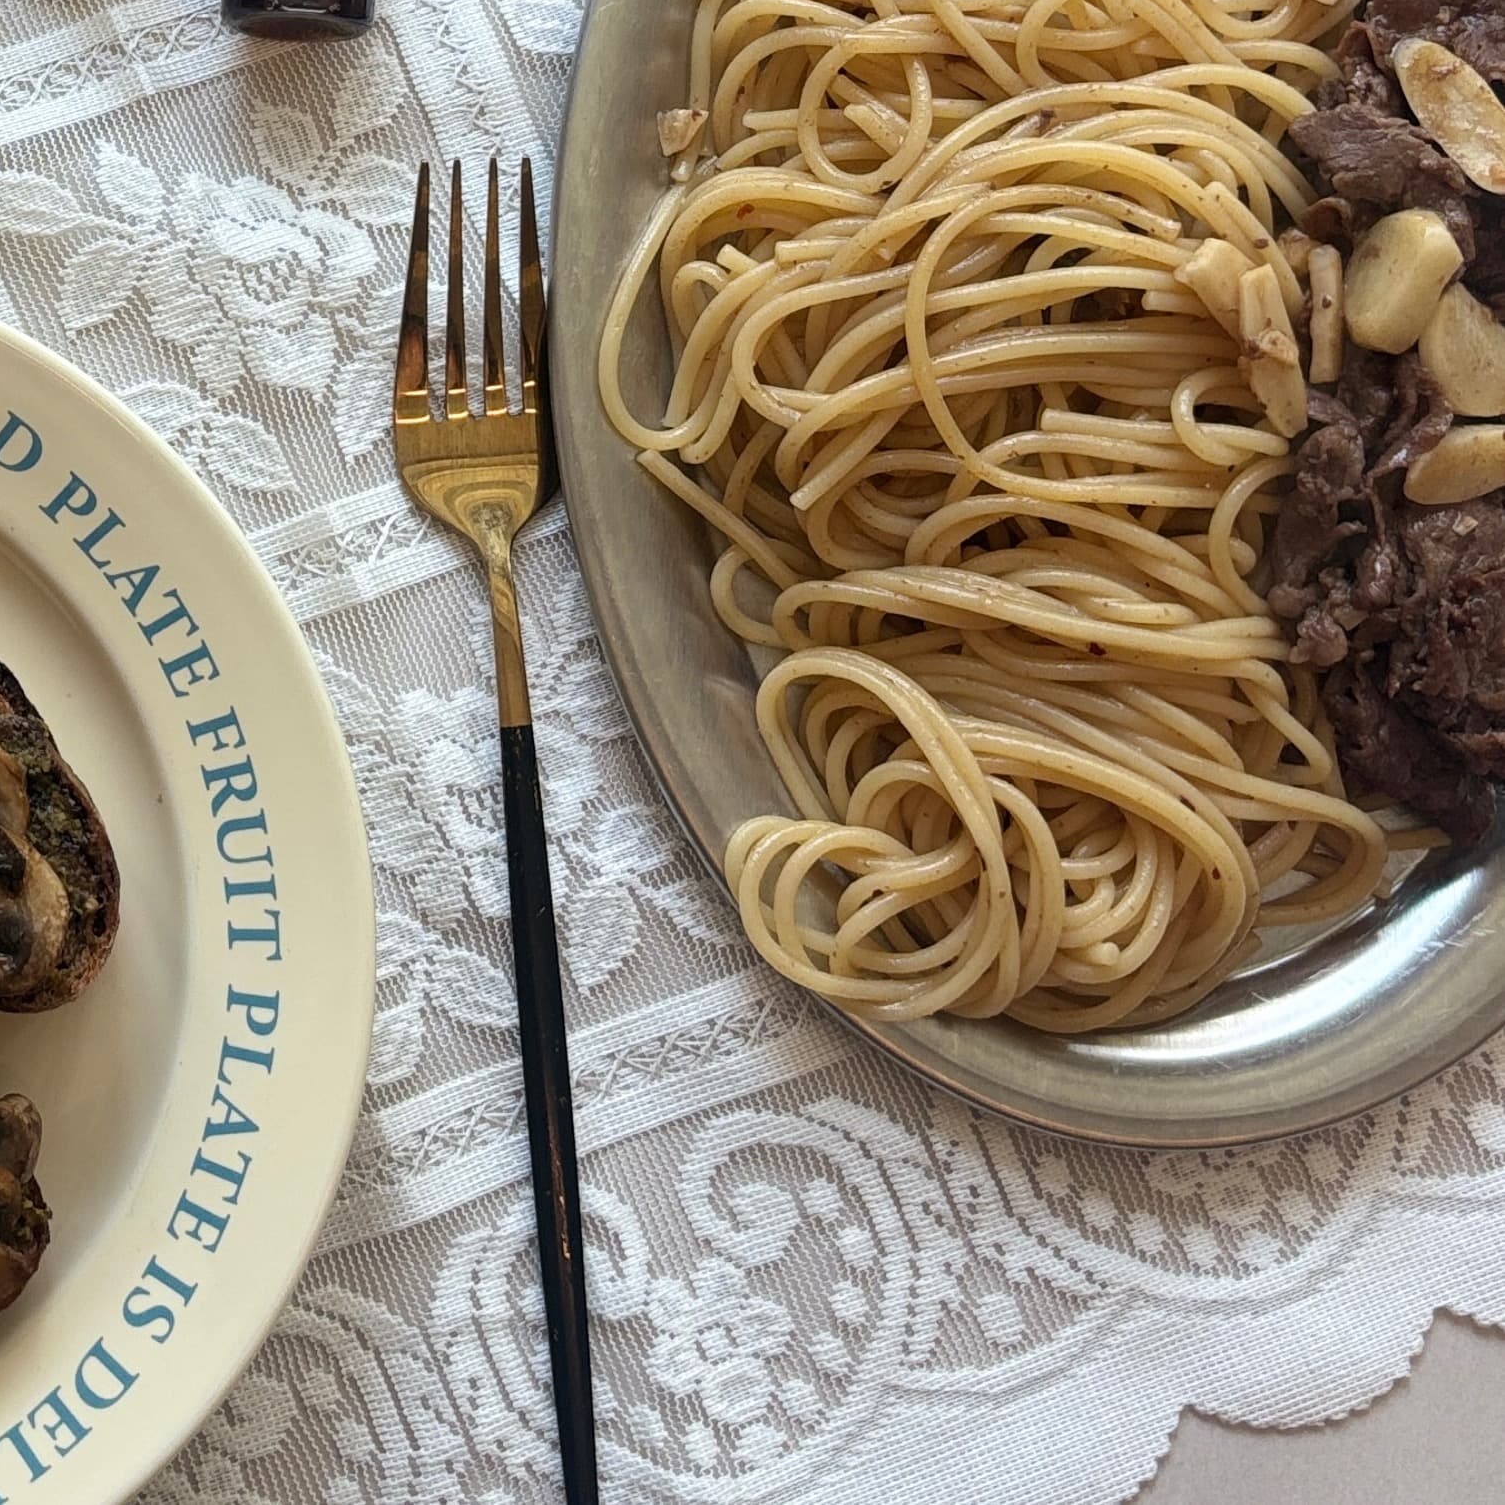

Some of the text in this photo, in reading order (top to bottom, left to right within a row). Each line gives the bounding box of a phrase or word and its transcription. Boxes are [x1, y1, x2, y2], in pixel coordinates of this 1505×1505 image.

[39, 471, 221, 698] PLATE
[186, 705, 283, 962] FRUIT
[166, 983, 280, 1253] PLATE
[122, 1254, 199, 1345] IS
